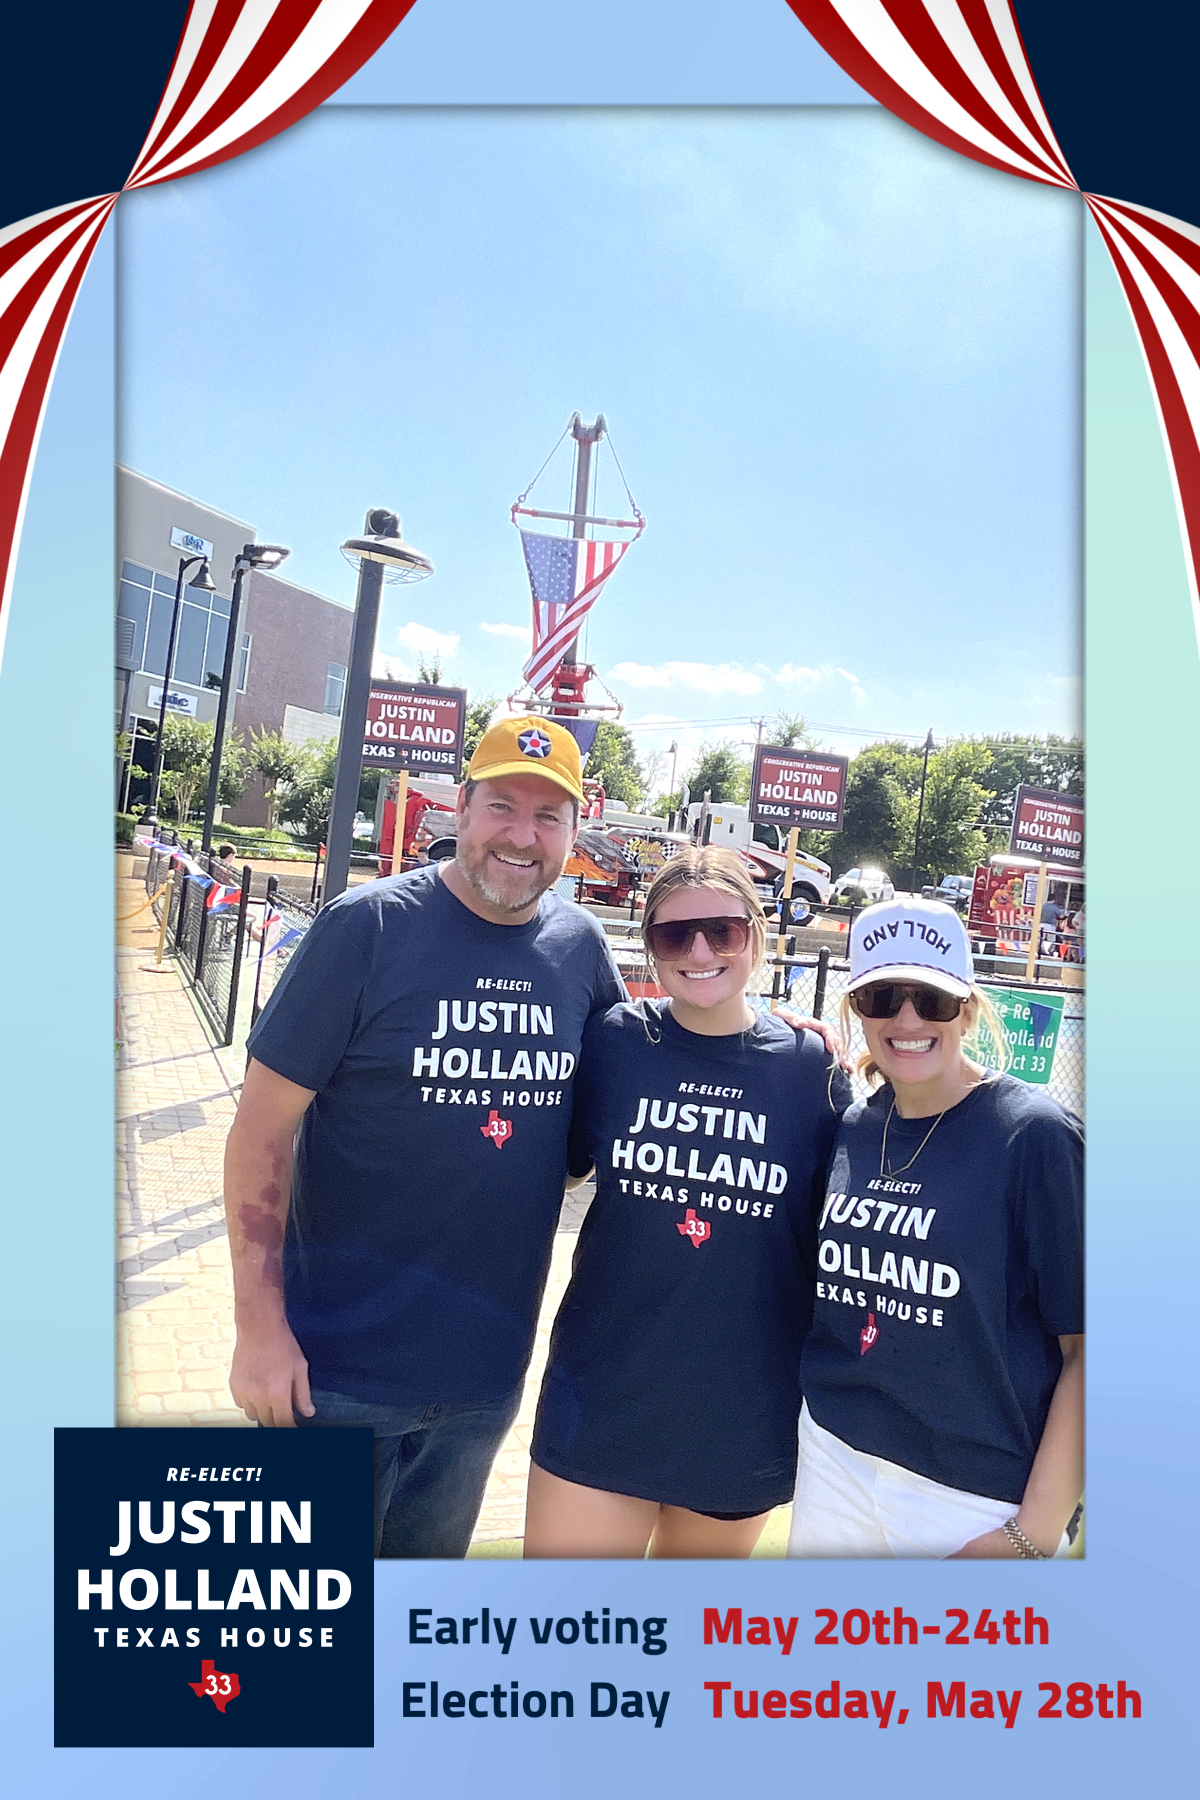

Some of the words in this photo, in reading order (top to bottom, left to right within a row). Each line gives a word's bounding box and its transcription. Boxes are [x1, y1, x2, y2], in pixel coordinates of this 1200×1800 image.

[369, 692, 413, 703] NSERVATIVE
[414, 698, 457, 708] REPUBLICAN
[378, 704, 436, 722] JUSTIN
[362, 744, 396, 758] EXAS
[411, 749, 456, 764] HOUSE
[764, 758, 805, 769] CONSERVATIVE
[806, 764, 840, 773] REPUBLICAN
[777, 769, 822, 785] JUSTIN
[760, 783, 837, 805] HOLLAND
[757, 804, 790, 816] TEXAS
[802, 809, 837, 822] HOUSE
[1034, 809, 1071, 826] JUSTIN
[1018, 821, 1082, 844] HOLLAND
[1016, 840, 1043, 852] TEXAS
[1052, 846, 1081, 859] HOUSE
[862, 920, 952, 955] HOLLAND
[476, 977, 533, 992] RE-ELECT!
[432, 1000, 554, 1040] JUSTIN
[412, 1046, 576, 1081] HOLLAND
[1030, 1056, 1046, 1072] 33
[421, 1086, 492, 1105] TEXAS
[502, 1090, 562, 1106] HOUSE
[678, 1082, 744, 1099] RE-ELECT!
[490, 1120, 508, 1136] 33
[629, 1098, 767, 1144] JUSTIN
[612, 1139, 788, 1195] HOLLAND
[867, 1179, 922, 1194] RE-ELECT!
[619, 1178, 689, 1204] TEXAS
[700, 1192, 774, 1218] HOUSE
[819, 1192, 937, 1241] JUSTIN
[686, 1220, 706, 1237] 33
[818, 1239, 960, 1298] OLLAND
[816, 1282, 868, 1307] EXAS
[876, 1295, 944, 1327] HOUSE
